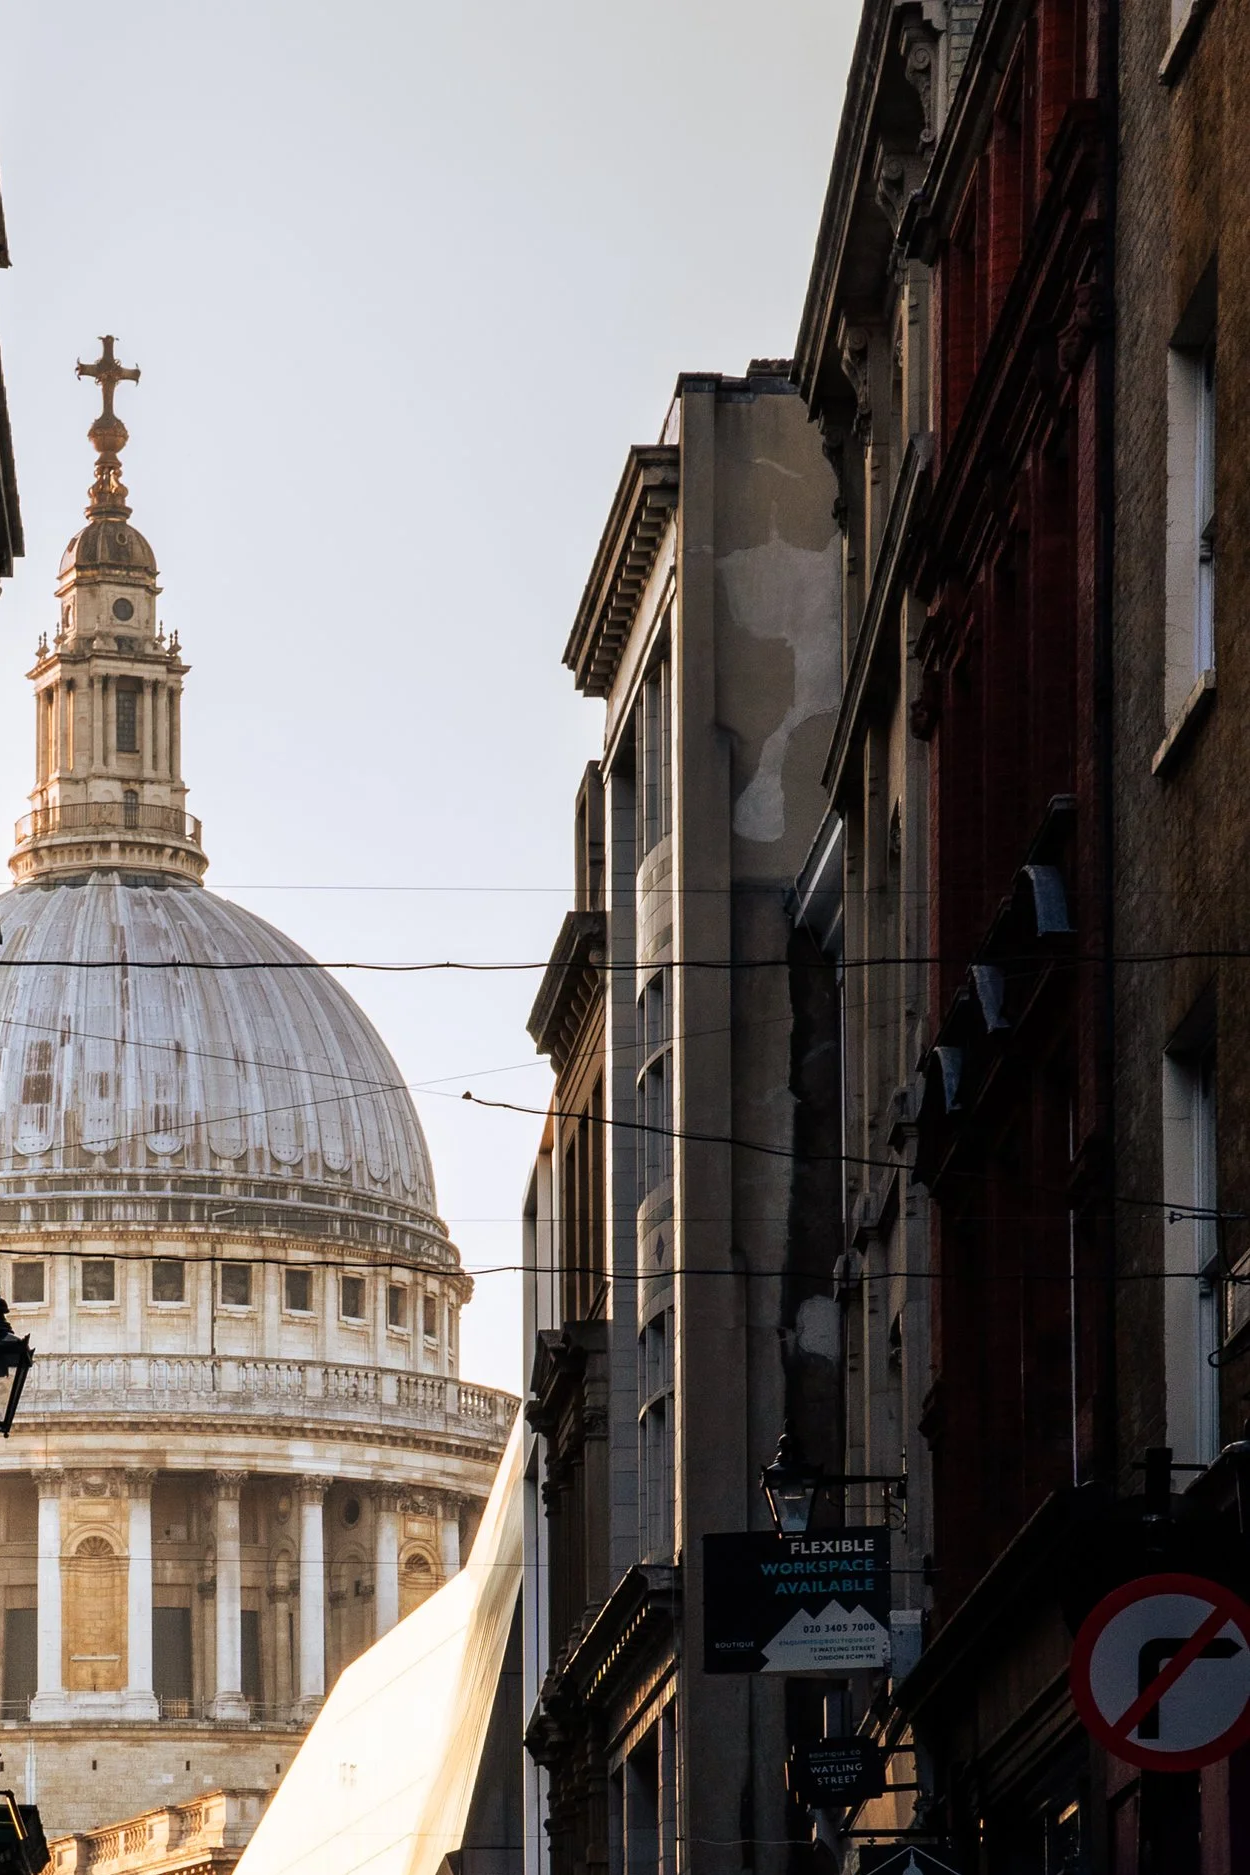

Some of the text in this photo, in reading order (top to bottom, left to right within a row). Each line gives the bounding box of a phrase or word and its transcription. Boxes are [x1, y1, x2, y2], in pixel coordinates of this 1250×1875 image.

[790, 1538, 875, 1555] FLEXIBLE
[760, 1558, 875, 1576] WORKSPACE
[774, 1578, 875, 1596] AVAILABLE
[803, 1622, 876, 1634] 020 3405 7000
[715, 1640, 755, 1650] BOUTIQUE
[810, 1762, 863, 1774] WATLING
[816, 1774, 858, 1786] STREET
